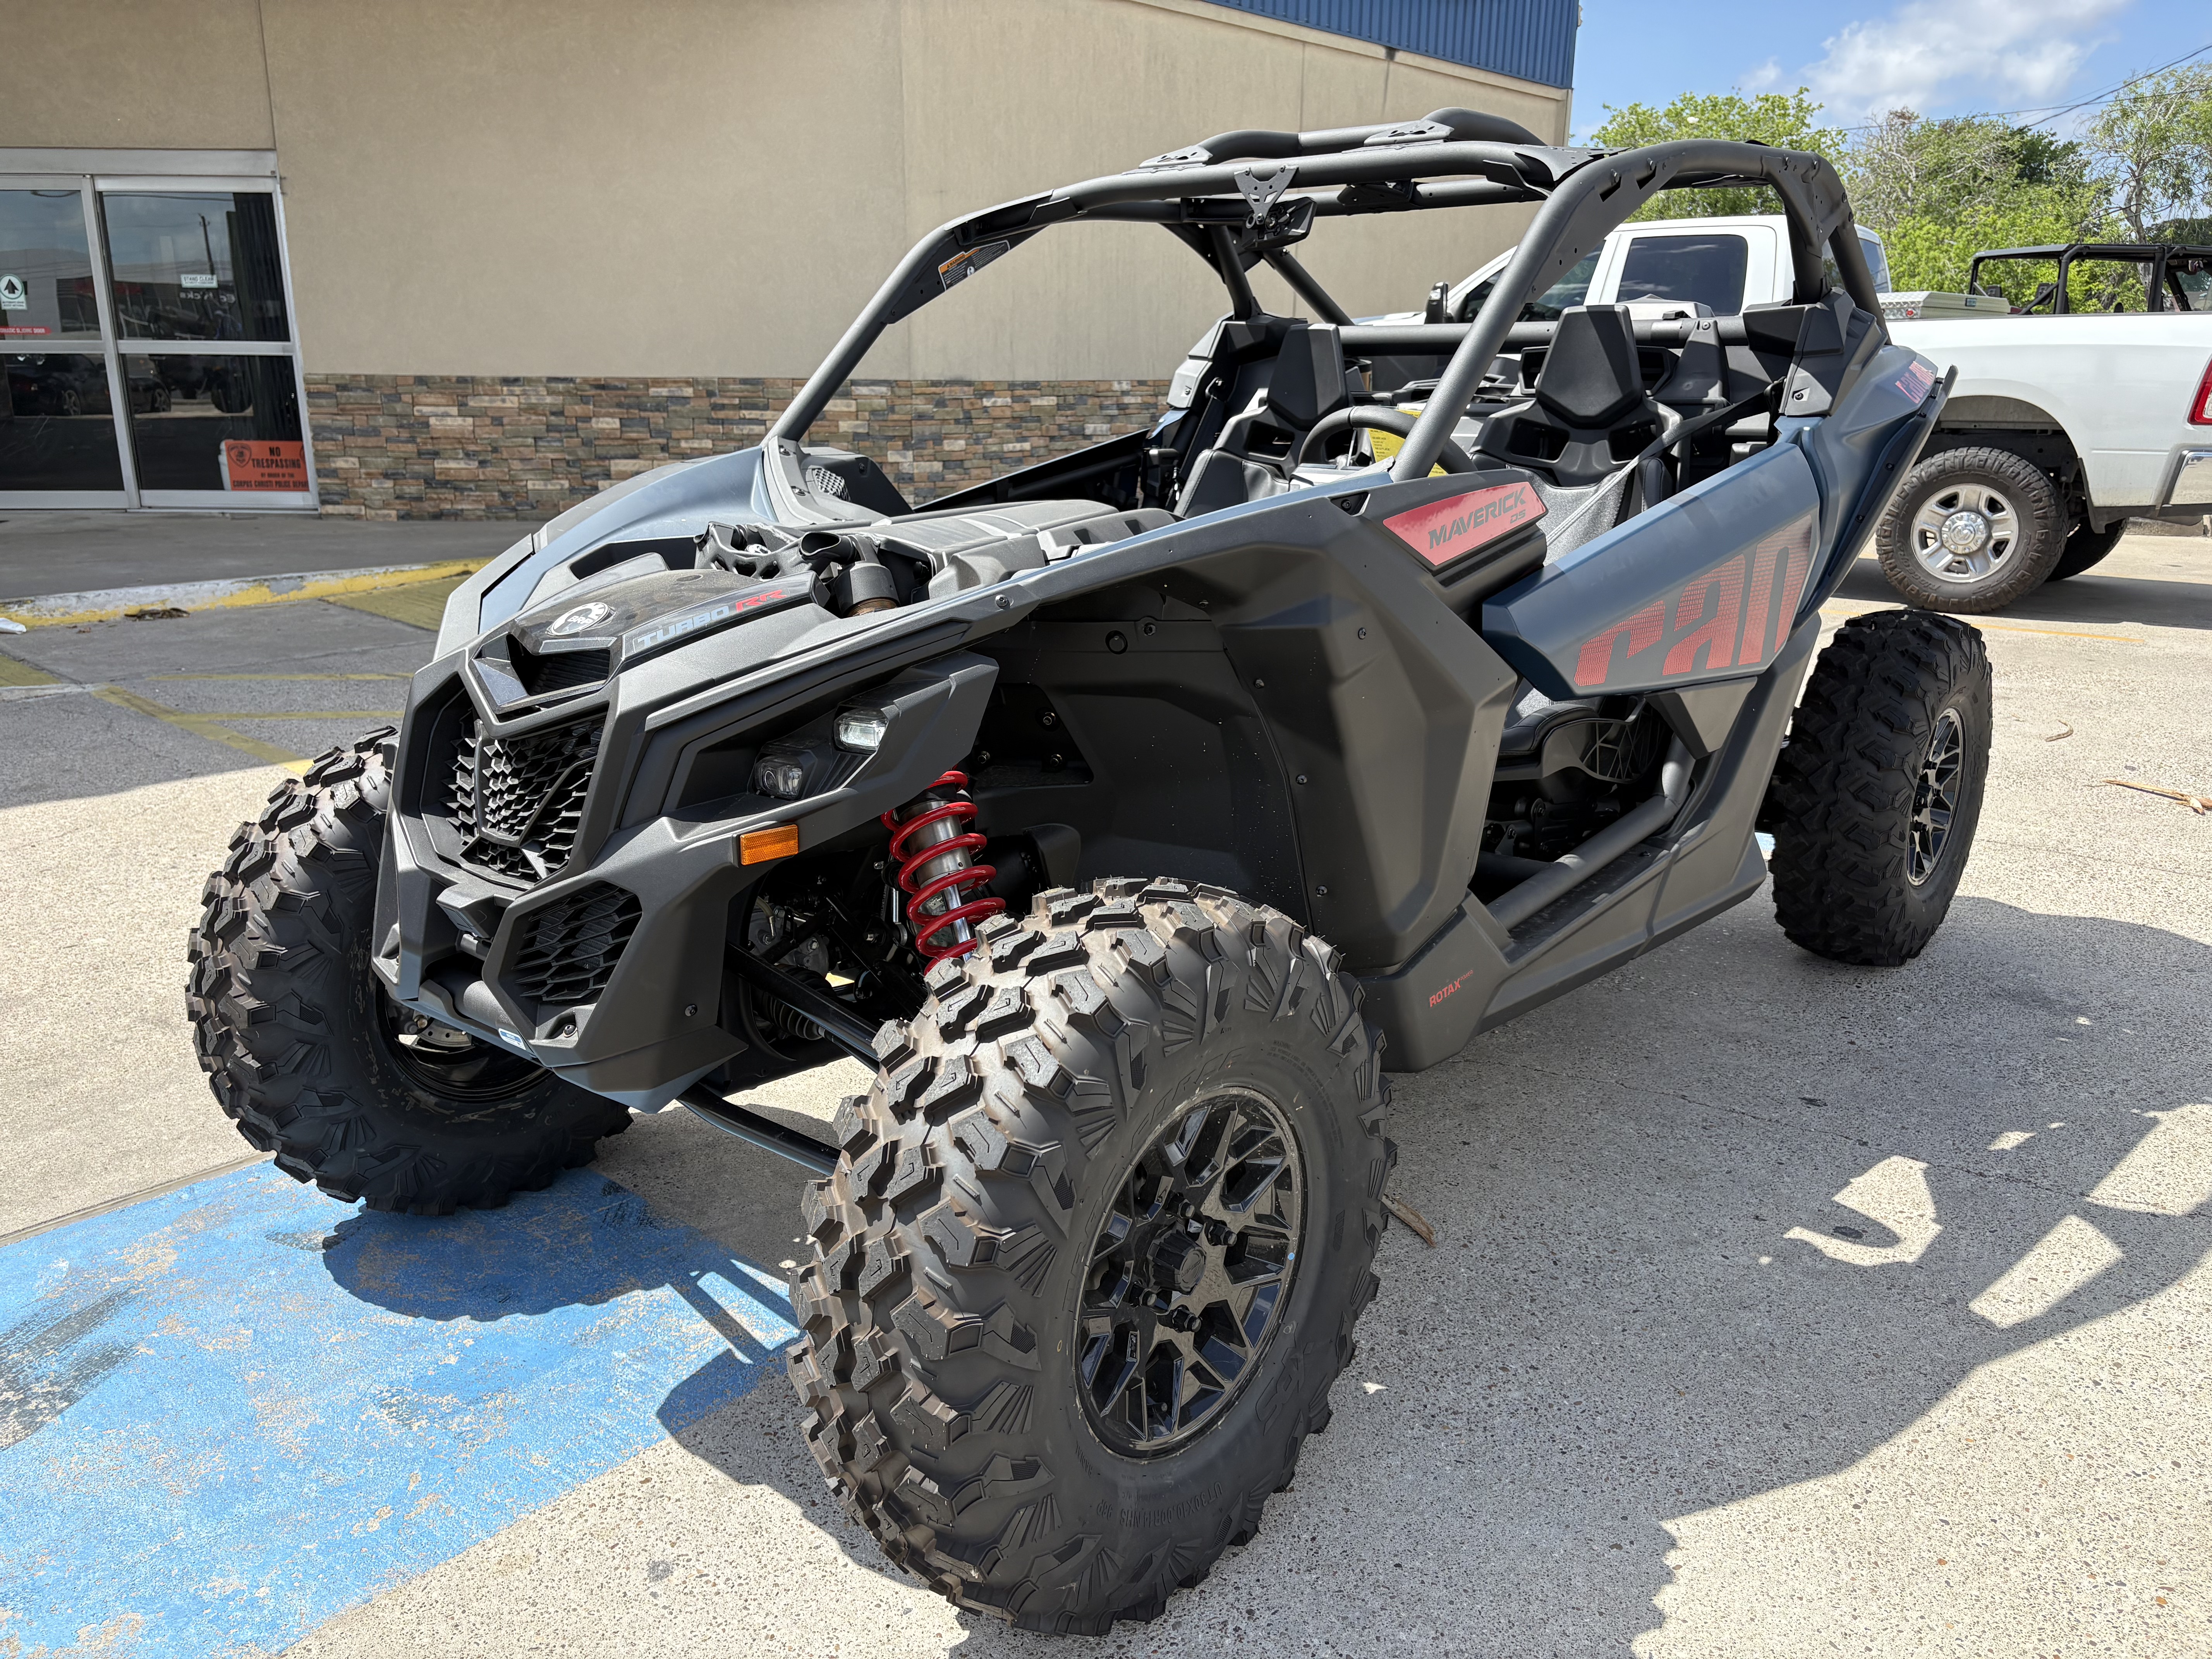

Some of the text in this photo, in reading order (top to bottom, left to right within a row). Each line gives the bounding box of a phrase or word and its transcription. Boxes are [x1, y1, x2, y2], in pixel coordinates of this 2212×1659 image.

[269, 447, 281, 457] NO
[252, 458, 301, 469] TRESPASSING
[1428, 486, 1526, 550] MAVERICK
[1510, 509, 1526, 524] DS
[567, 615, 594, 625] BRP
[637, 589, 787, 647] TURBO RR
[1429, 977, 1461, 1008] ROTAX
